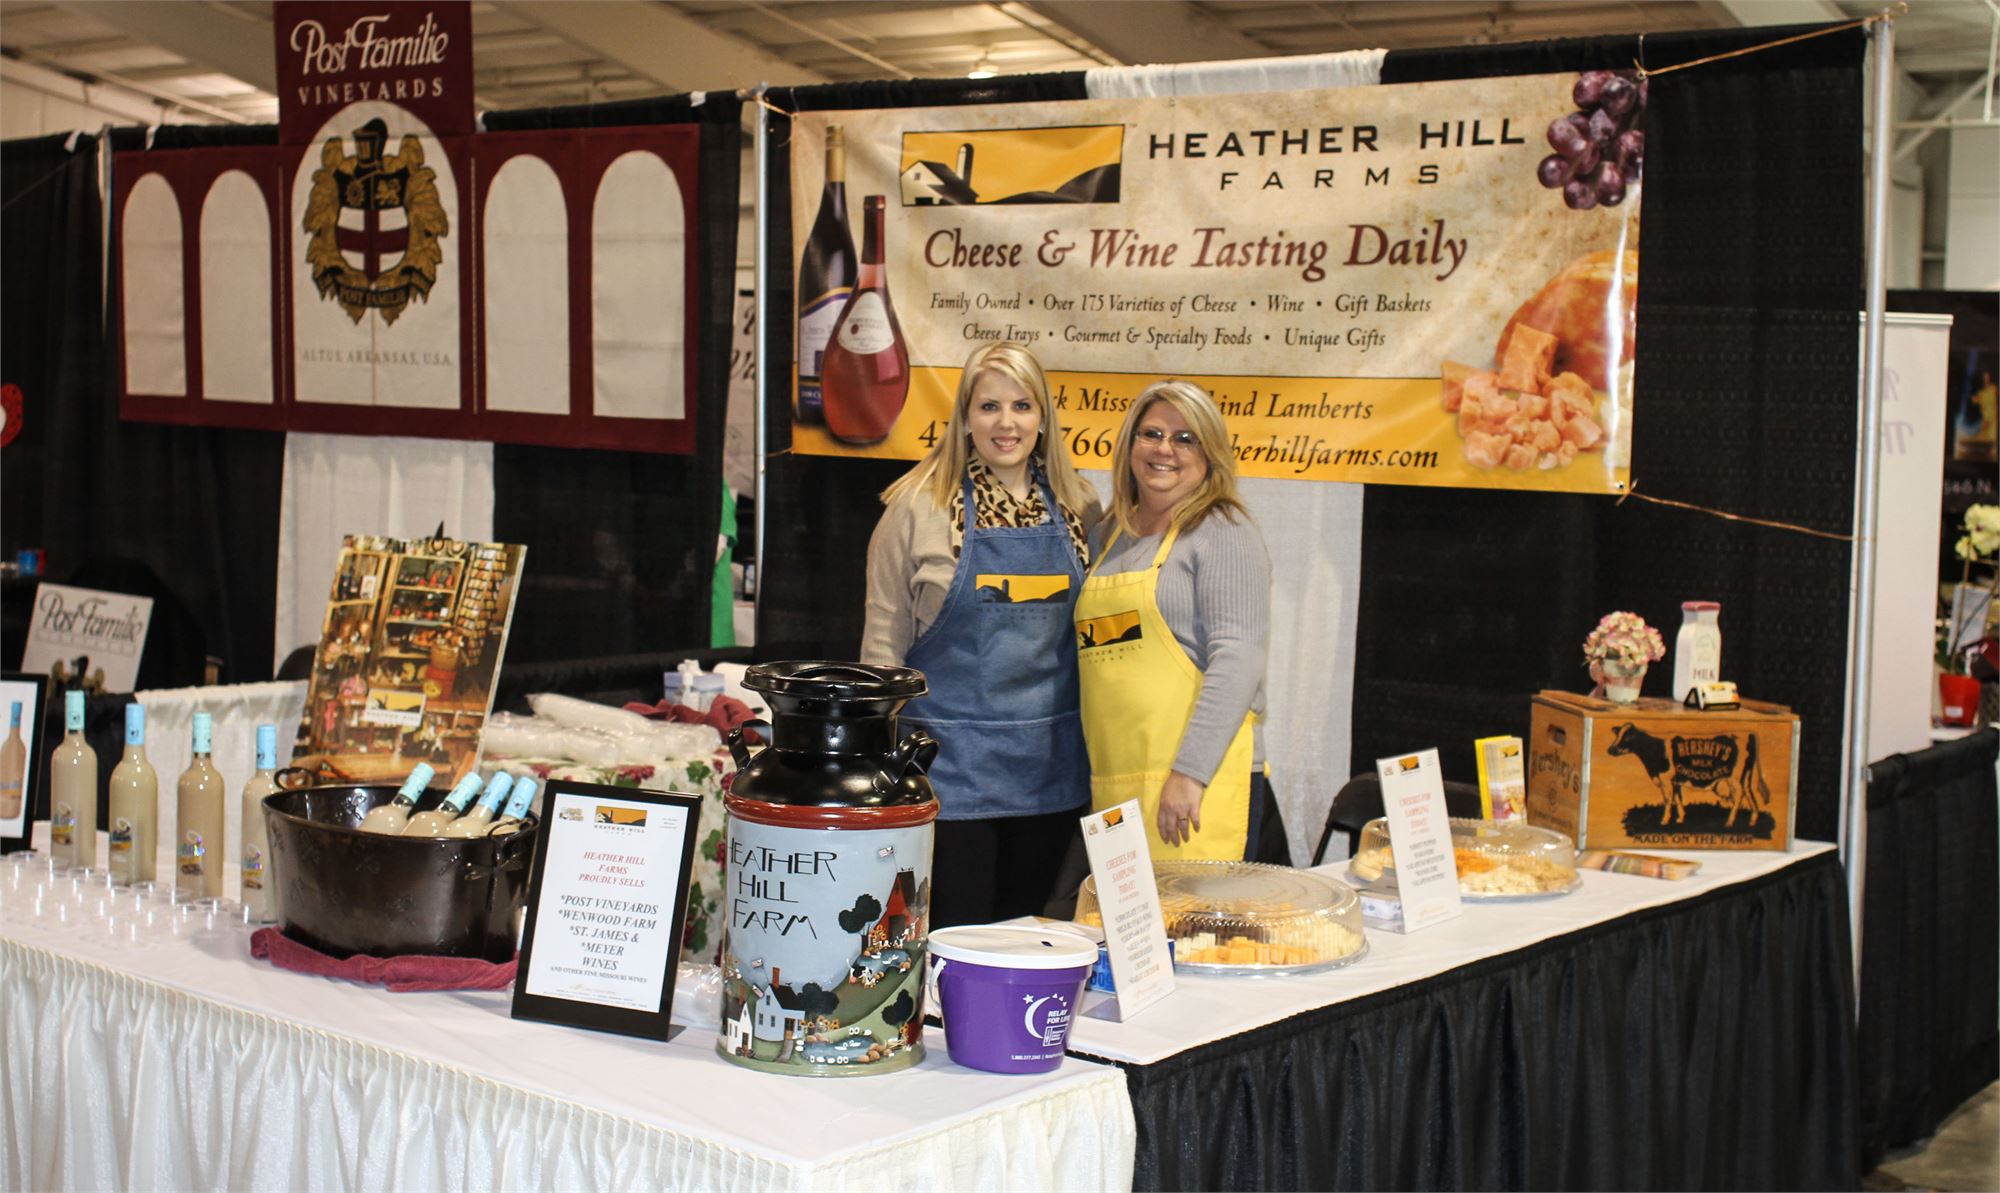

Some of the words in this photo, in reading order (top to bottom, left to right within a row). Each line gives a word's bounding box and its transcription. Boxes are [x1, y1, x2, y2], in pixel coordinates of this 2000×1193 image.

[290, 19, 352, 75] Post
[351, 12, 449, 69] Familie
[298, 77, 443, 106] VINEYARDS
[1150, 125, 1379, 159] HEATHER
[1420, 118, 1525, 150] HILL
[1220, 164, 1439, 191] FARMS
[924, 227, 1022, 268] Cheese
[1037, 229, 1076, 268] &
[1089, 229, 1179, 269] Wine
[1190, 227, 1328, 283] Tasting
[1342, 219, 1468, 282] Daily
[930, 292, 971, 315] Family
[976, 292, 1021, 311] Owned
[1043, 294, 1074, 312] Over
[1081, 294, 1104, 312] 175
[1109, 294, 1165, 312] Varieties
[1170, 295, 1186, 318] of
[1192, 294, 1237, 313] Cheese
[1267, 294, 1304, 313] Wine
[1335, 293, 1368, 318] Gift
[1376, 293, 1432, 313] Baskets
[963, 323, 1001, 342] Cheese
[1005, 324, 1040, 347] Trays
[1064, 324, 1120, 344] Gourmet
[1126, 326, 1141, 344] &
[1146, 326, 1208, 351] Specialty
[1214, 326, 1252, 346] Foods
[1284, 328, 1340, 352] Unique
[1346, 327, 1386, 347] Gifts
[1209, 390, 1258, 417] ind
[1265, 392, 1374, 420] Lamberts
[1231, 433, 1439, 474] herhillfarms.com
[40, 590, 81, 632] Post
[1676, 764, 1729, 780] CHOCOLATE
[1632, 834, 1668, 844] MADE
[1672, 834, 1690, 844] ON
[1694, 834, 1716, 844] THE
[1721, 834, 1754, 844] FARM
[584, 851, 625, 864] HEATHER
[626, 856, 646, 866] HILL
[598, 865, 629, 875] FARMS
[579, 874, 618, 885] PROUDLY
[619, 878, 646, 888] SELLS
[594, 898, 659, 915] VINEYARDS
[623, 917, 657, 930] FARM
[733, 898, 818, 940] FARM
[591, 928, 630, 942] JAMES
[631, 932, 640, 943] &
[582, 957, 619, 971] WINES
[598, 972, 628, 982] MISSOURI
[1046, 1017, 1060, 1025] FOR
[1047, 1009, 1068, 1018] RELAY
